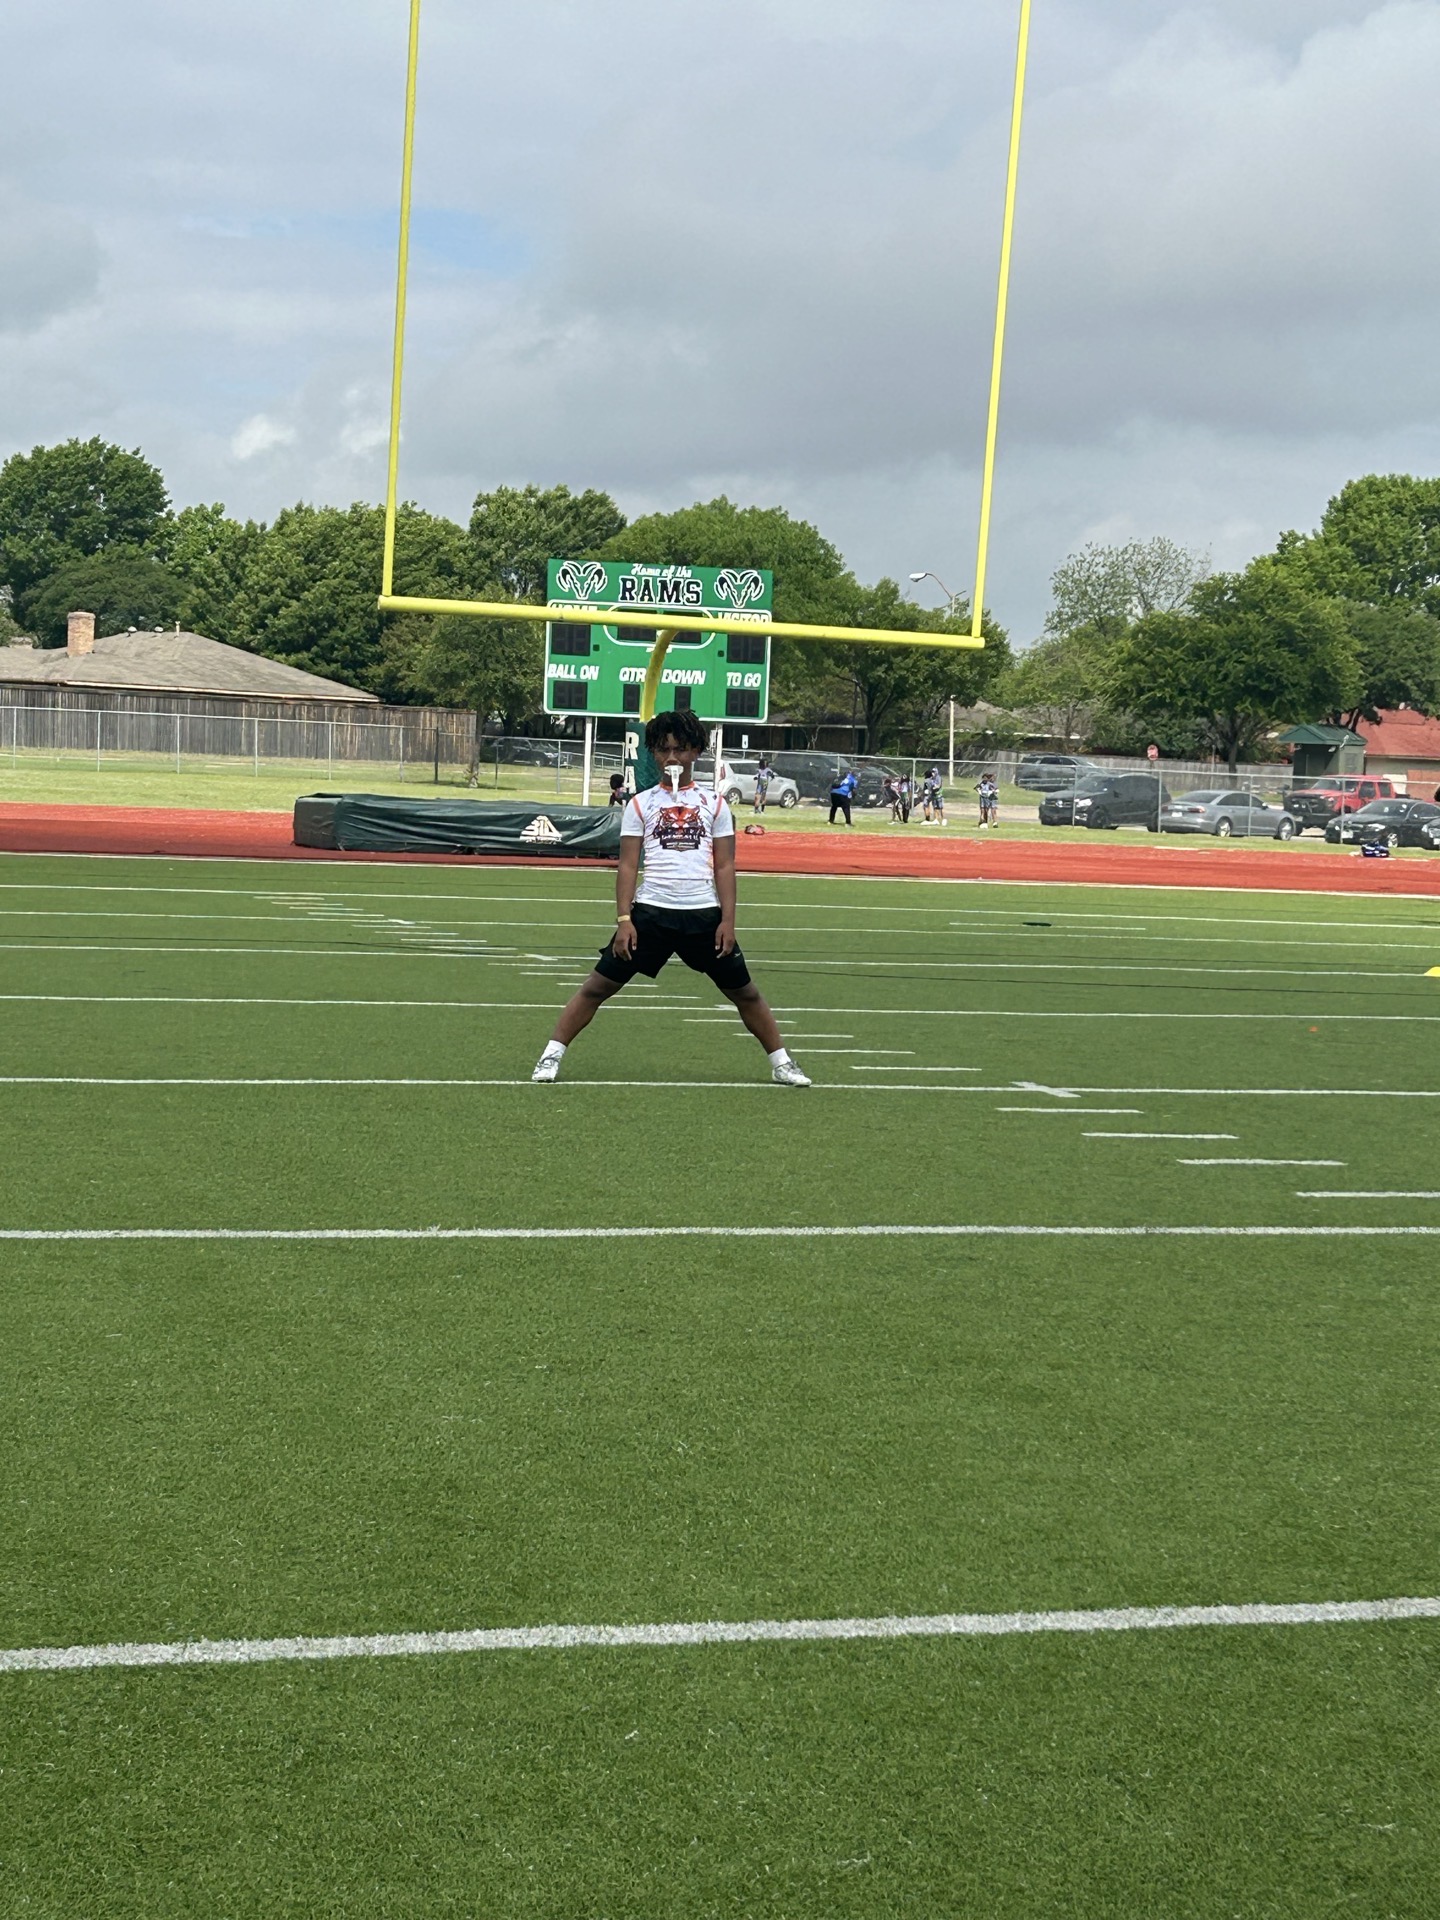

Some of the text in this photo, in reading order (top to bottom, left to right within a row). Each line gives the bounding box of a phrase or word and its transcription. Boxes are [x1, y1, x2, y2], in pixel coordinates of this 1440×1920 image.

[631, 563, 692, 579] Home of the
[618, 575, 702, 605] RAMS
[547, 663, 599, 681] BALL ON
[619, 667, 647, 682] QTR
[661, 669, 706, 685] DOWN
[726, 672, 761, 687] TO GO
